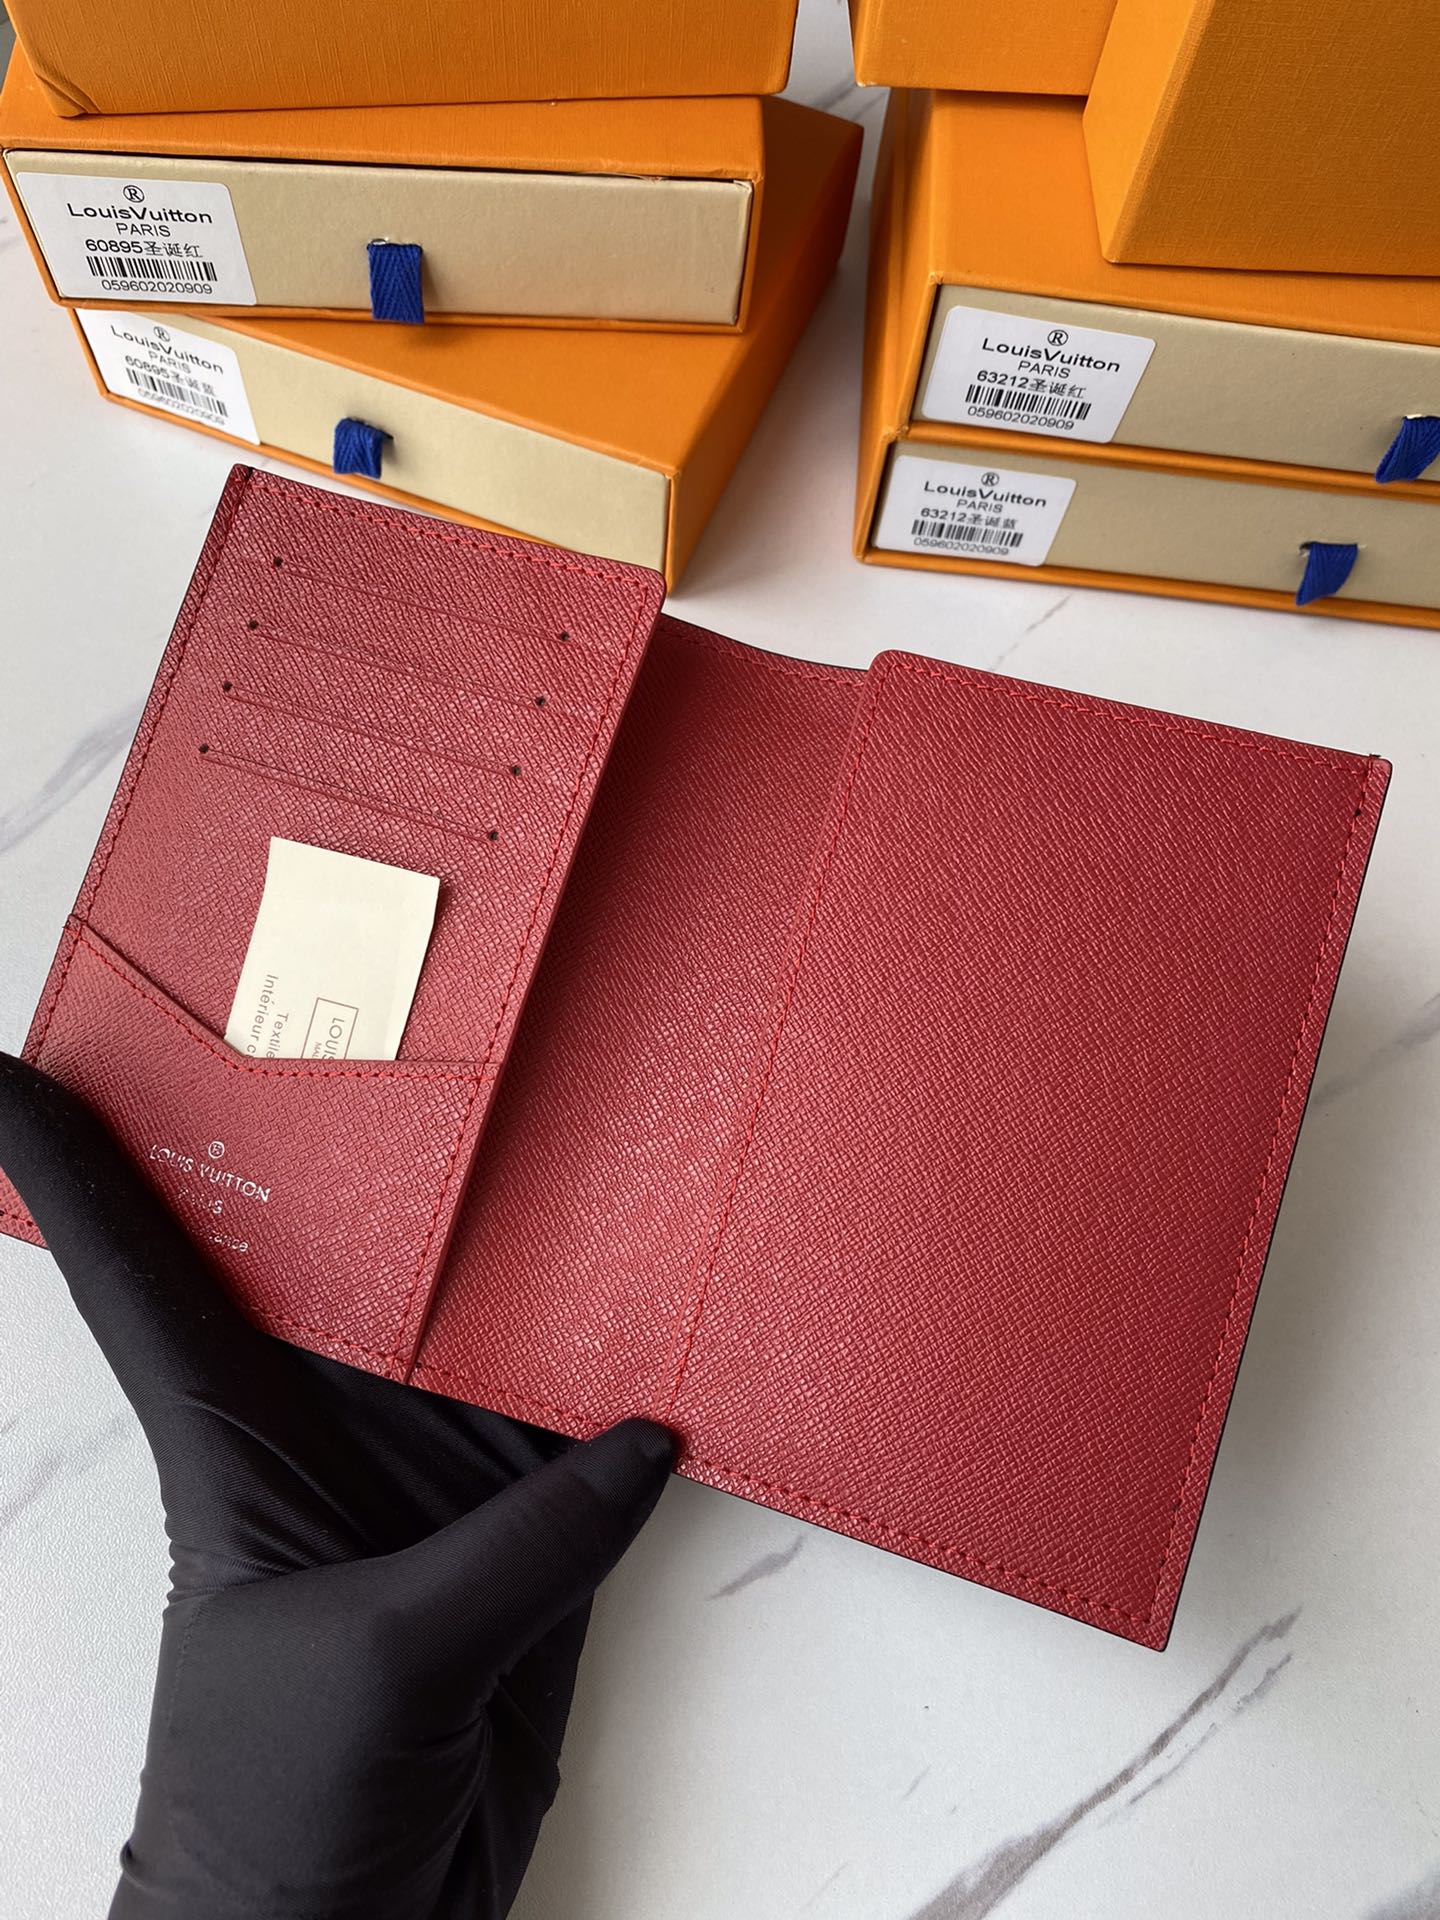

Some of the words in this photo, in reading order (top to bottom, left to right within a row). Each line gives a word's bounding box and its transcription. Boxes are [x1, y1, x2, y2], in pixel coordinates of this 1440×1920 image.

[67, 203, 213, 224] LouisVuitton
[116, 222, 171, 237] PARIS
[85, 238, 203, 258] 60895圣诞红
[101, 279, 213, 294] 059602020909
[110, 325, 224, 374] LouisVuitton
[982, 338, 1120, 372] LouisVuitton
[148, 350, 191, 374] PARIS
[1018, 360, 1071, 379] PARIS
[976, 370, 1087, 399] 63212圣诞红
[967, 405, 1075, 430] 059602020909
[924, 481, 1047, 508] LouisVuitton
[956, 499, 1004, 514] PARIS
[913, 537, 1009, 556] 059602020909
[250, 974, 279, 1041] Intérieur
[266, 1012, 289, 1058] Textile
[150, 1144, 194, 1172] LOUIS
[199, 1163, 271, 1203] VUITTON
